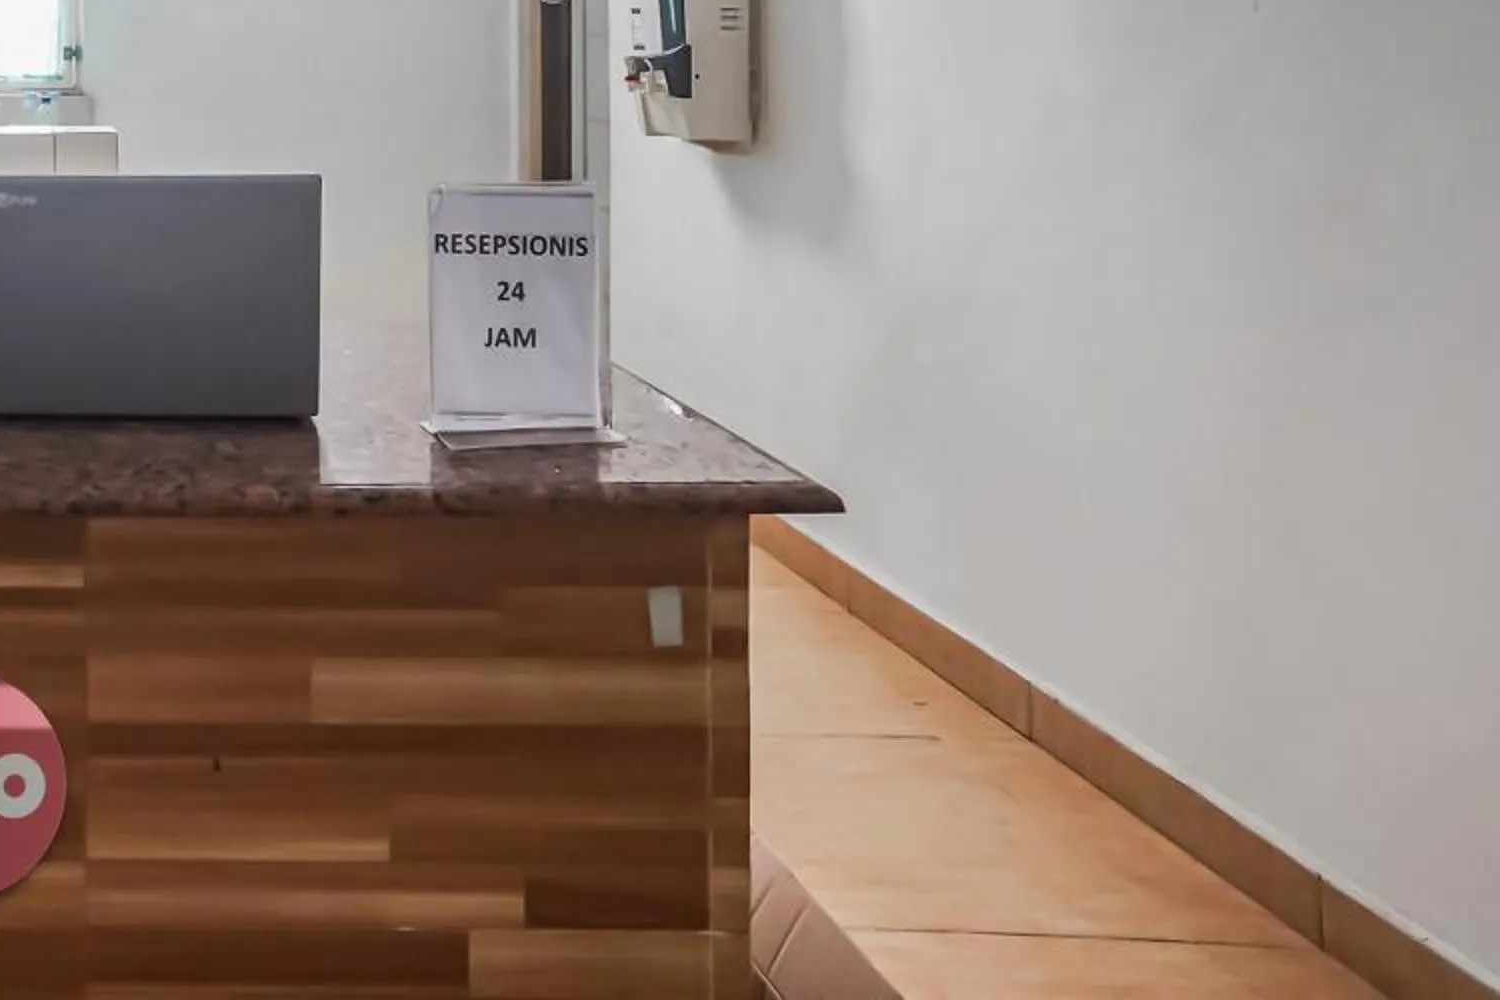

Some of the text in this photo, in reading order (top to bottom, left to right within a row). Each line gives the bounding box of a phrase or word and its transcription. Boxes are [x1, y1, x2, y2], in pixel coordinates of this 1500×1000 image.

[434, 233, 589, 257] RESEPSIONIS
[497, 281, 526, 302] 24
[484, 327, 537, 349] JAM
